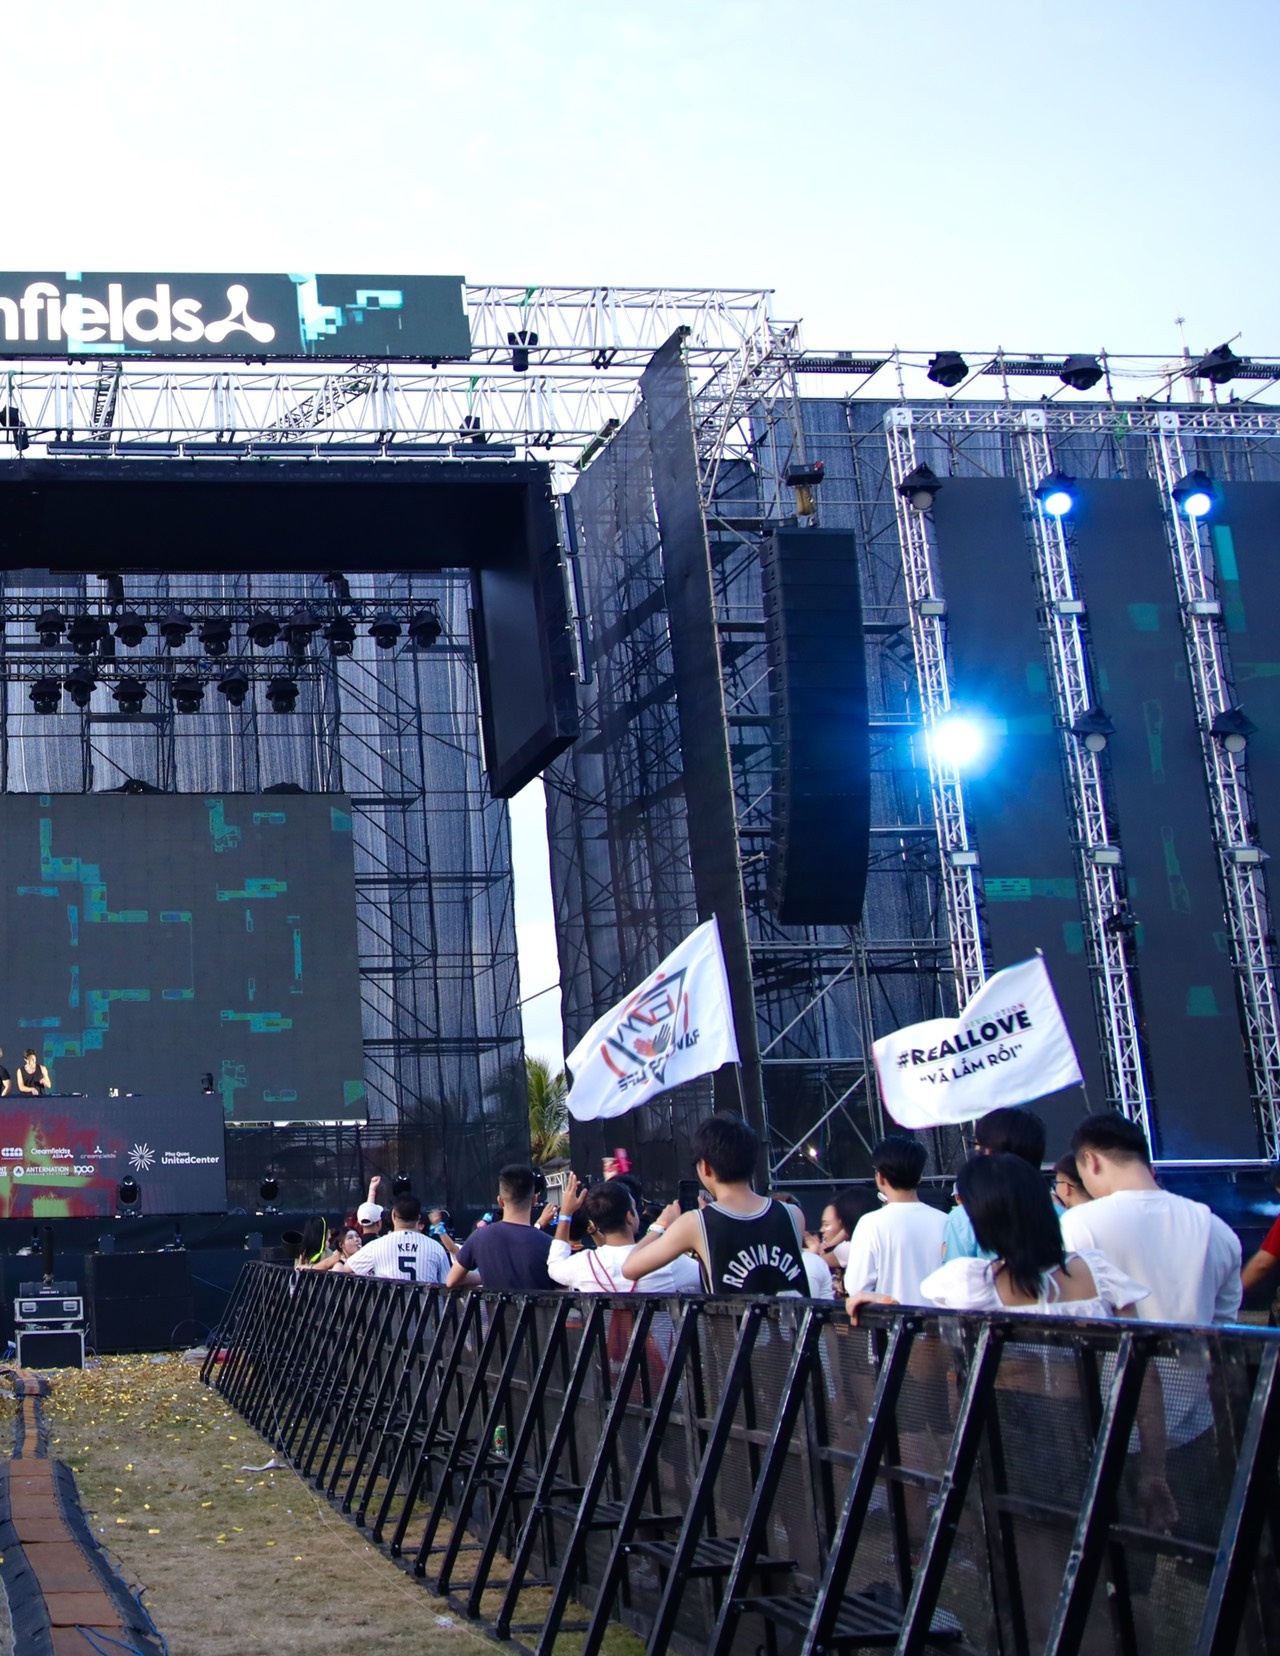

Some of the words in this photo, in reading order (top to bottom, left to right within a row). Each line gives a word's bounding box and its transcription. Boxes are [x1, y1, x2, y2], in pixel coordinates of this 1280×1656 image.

[73, 1165, 95, 1176] 1900
[397, 1243, 418, 1252] KEN
[398, 1256, 416, 1281] 5
[722, 1244, 801, 1288] ROBINSON
